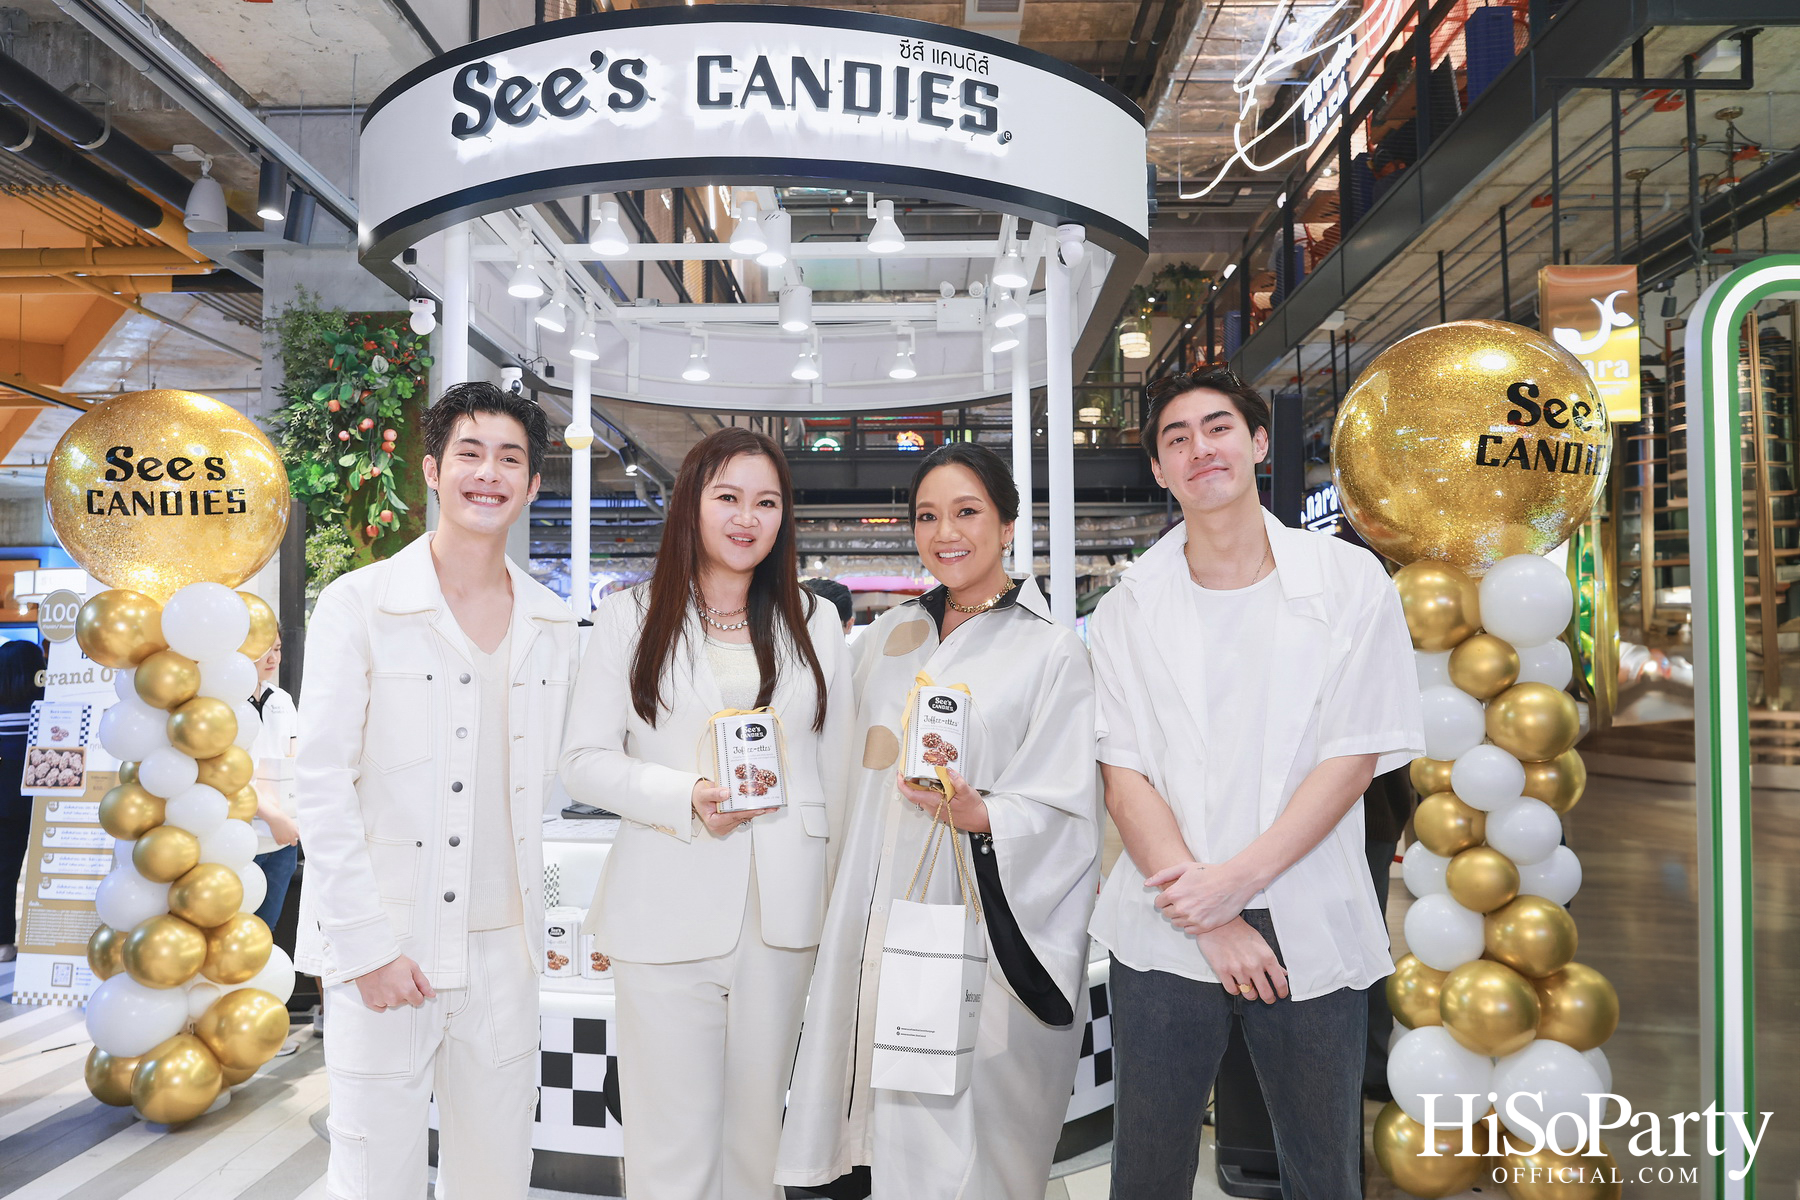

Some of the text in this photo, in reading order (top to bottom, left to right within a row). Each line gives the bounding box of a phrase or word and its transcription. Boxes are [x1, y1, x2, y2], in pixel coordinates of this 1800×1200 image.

[451, 49, 1000, 141] See's CANDIES
[86, 488, 247, 517] CANDIES
[42, 602, 80, 623] 100
[33, 667, 95, 688] Grand
